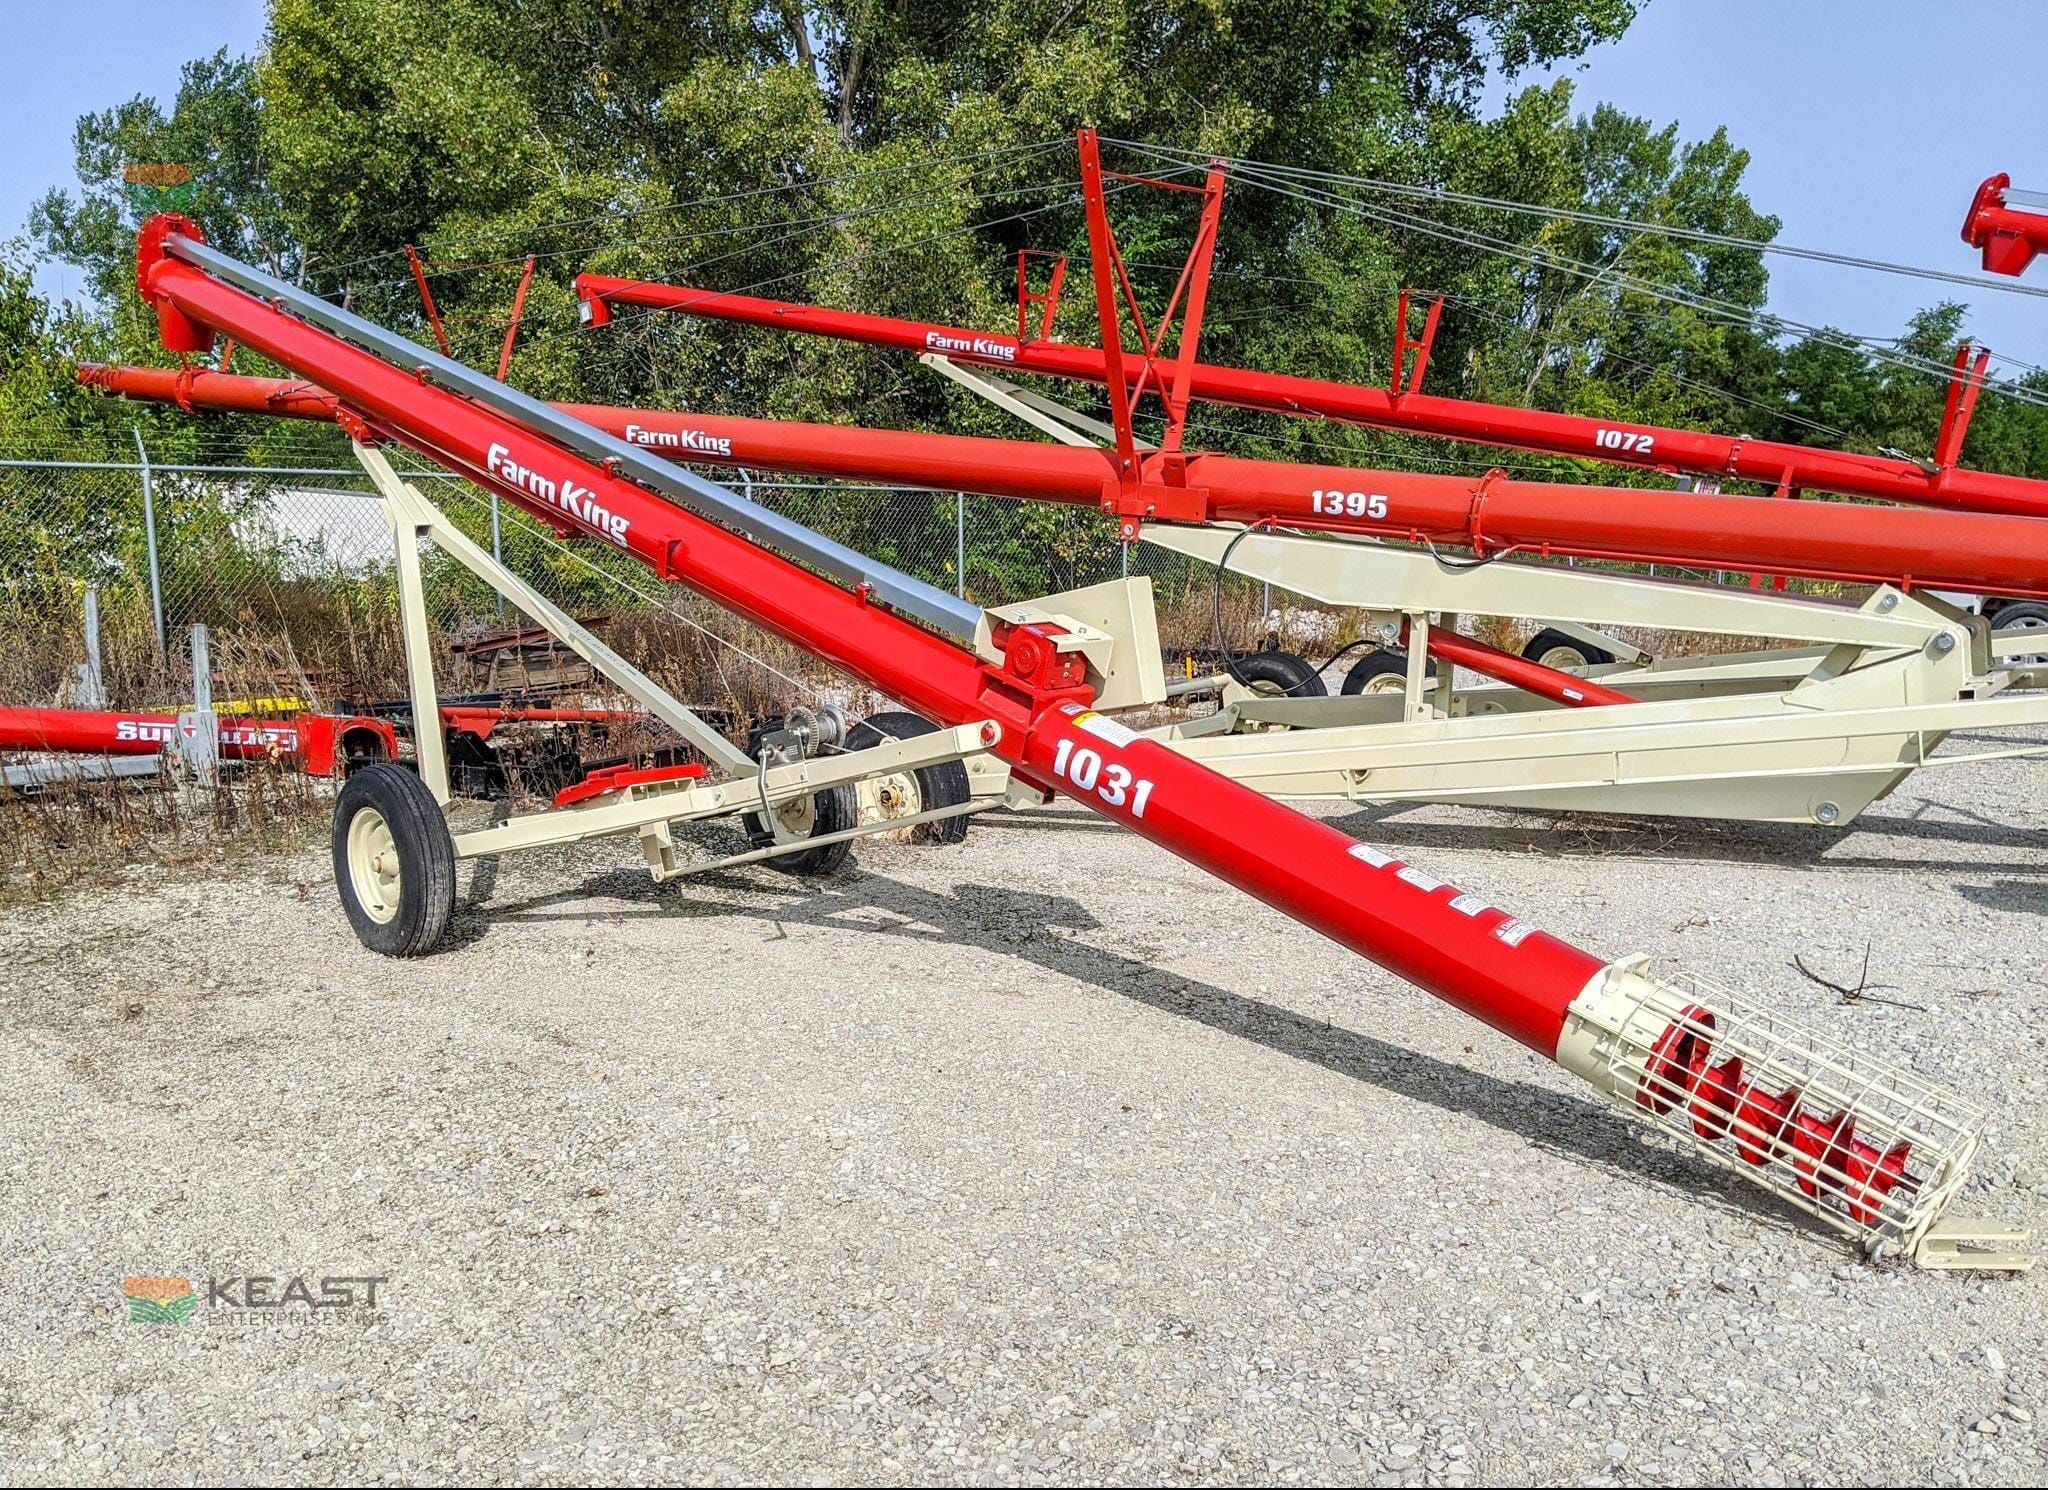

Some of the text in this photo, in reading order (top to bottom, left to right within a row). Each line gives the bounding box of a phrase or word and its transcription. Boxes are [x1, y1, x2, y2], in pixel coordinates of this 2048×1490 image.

[926, 331, 1016, 361] Farm King
[626, 424, 732, 457] Farm King
[1595, 429, 1655, 454] 1072
[487, 442, 631, 549] Farm King
[1311, 489, 1388, 519] 1395
[115, 720, 172, 744] ing
[1053, 738, 1155, 819] 1031
